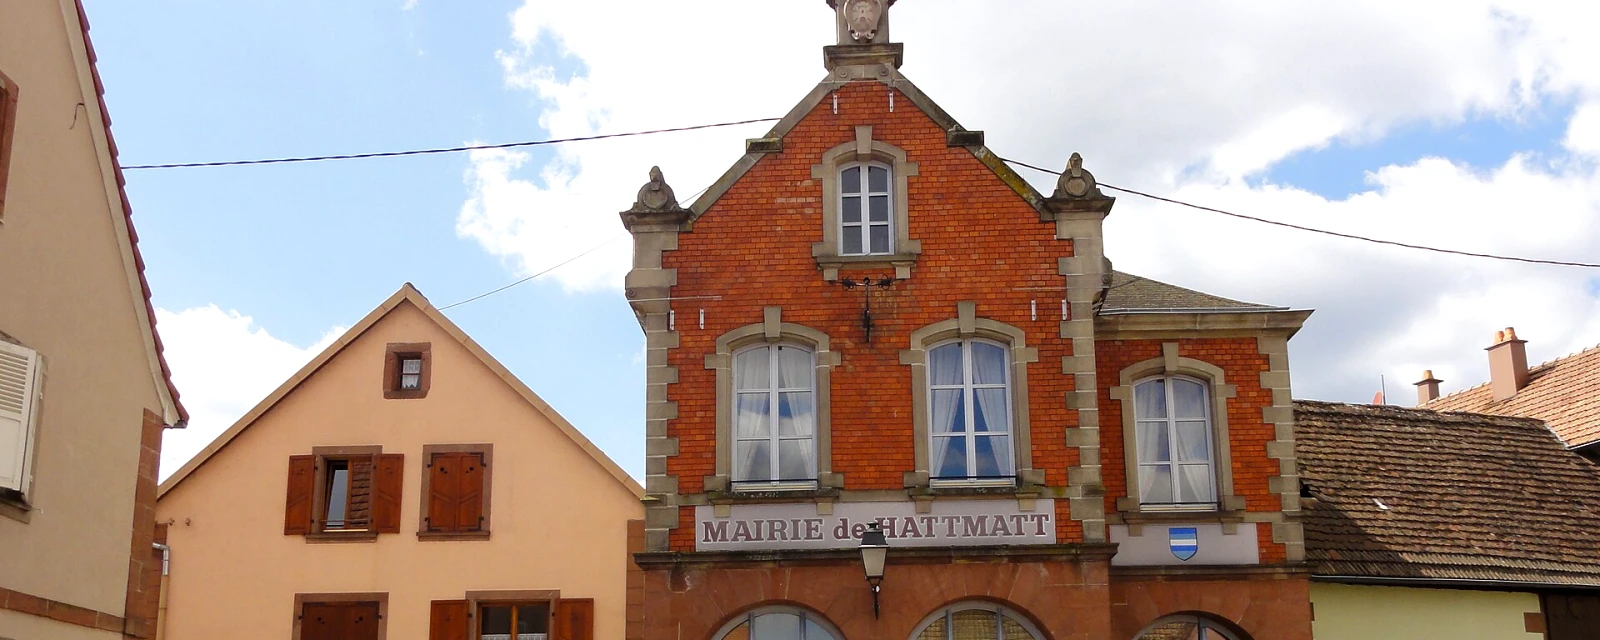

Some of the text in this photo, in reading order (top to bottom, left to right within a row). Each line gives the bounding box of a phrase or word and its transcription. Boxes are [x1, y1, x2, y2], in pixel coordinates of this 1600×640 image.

[702, 514, 1050, 542] MAIRIE de HATTMATT
